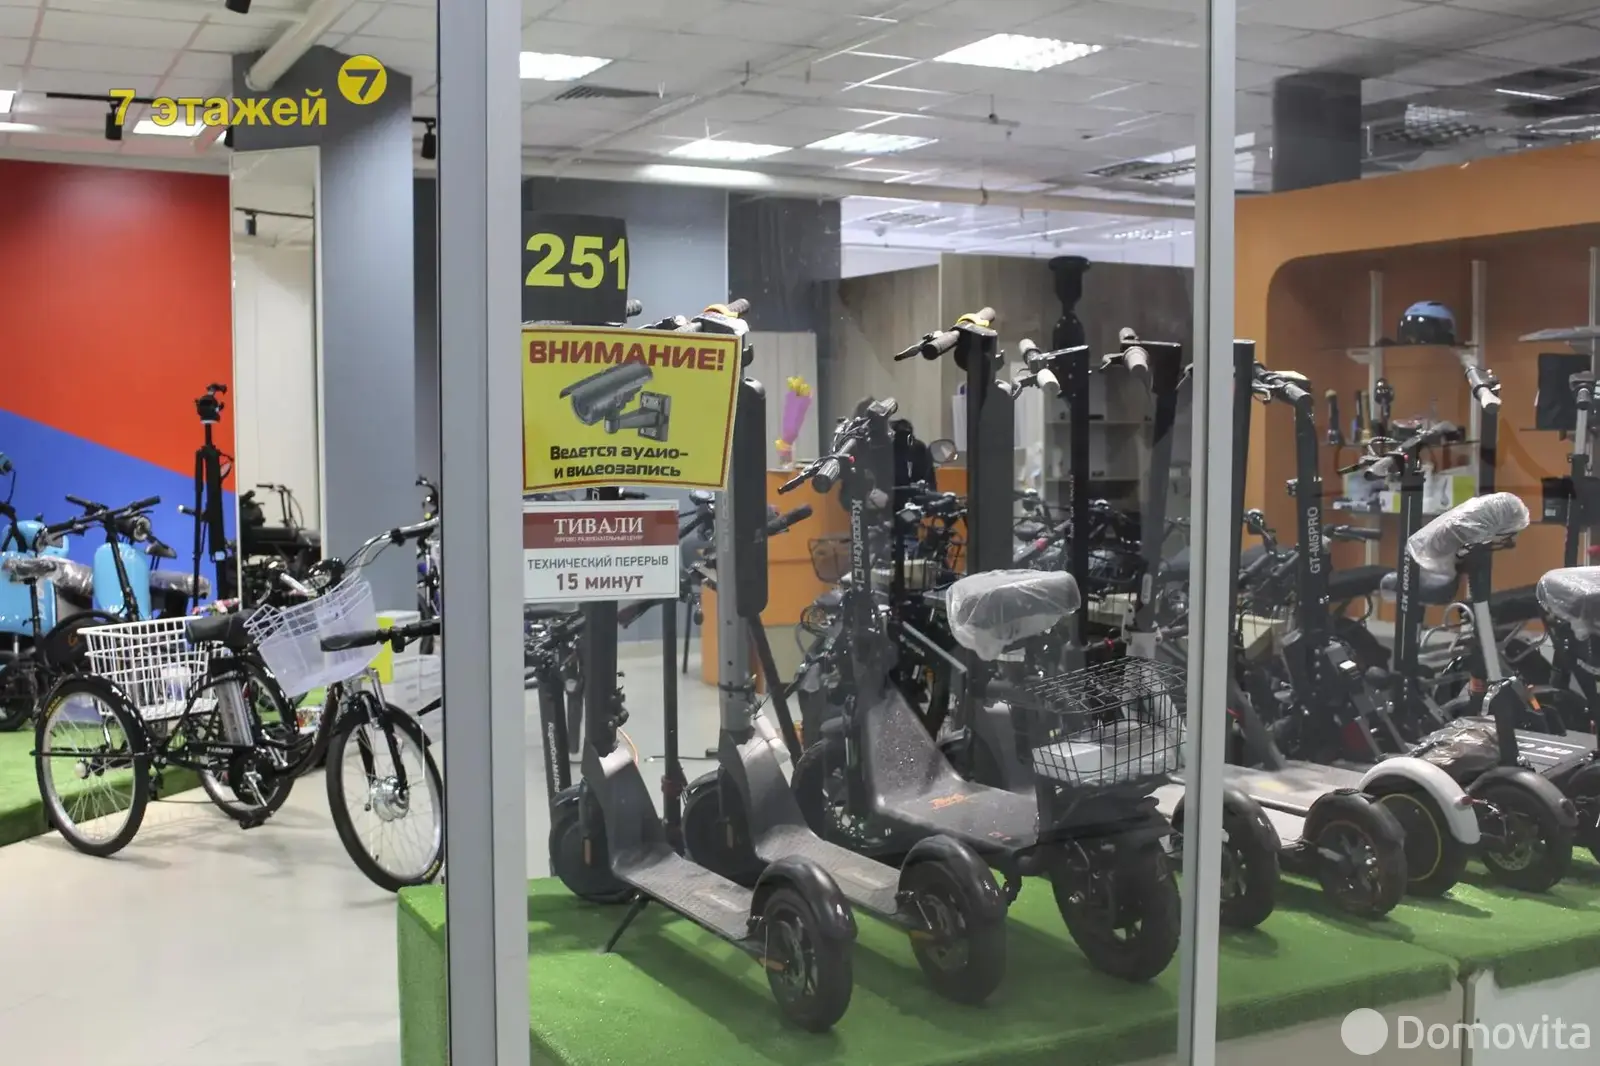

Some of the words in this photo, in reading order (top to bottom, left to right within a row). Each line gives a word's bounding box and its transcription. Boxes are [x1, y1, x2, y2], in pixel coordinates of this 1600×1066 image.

[525, 233, 626, 290] 251
[529, 340, 725, 371] ВНИМАНИЕ!
[550, 445, 617, 462] Ведется
[620, 446, 689, 462] аудио-
[554, 468, 563, 480] и
[566, 463, 681, 479] видеозапись
[554, 517, 644, 536] ТИВАЛИ
[1306, 506, 1321, 574] GT-M5PRO
[528, 555, 612, 570] ТЕХНИЧЕСКИЙ
[615, 555, 669, 568] ПЕРЕРЫВ
[556, 573, 579, 591] 15
[585, 574, 644, 592] минут
